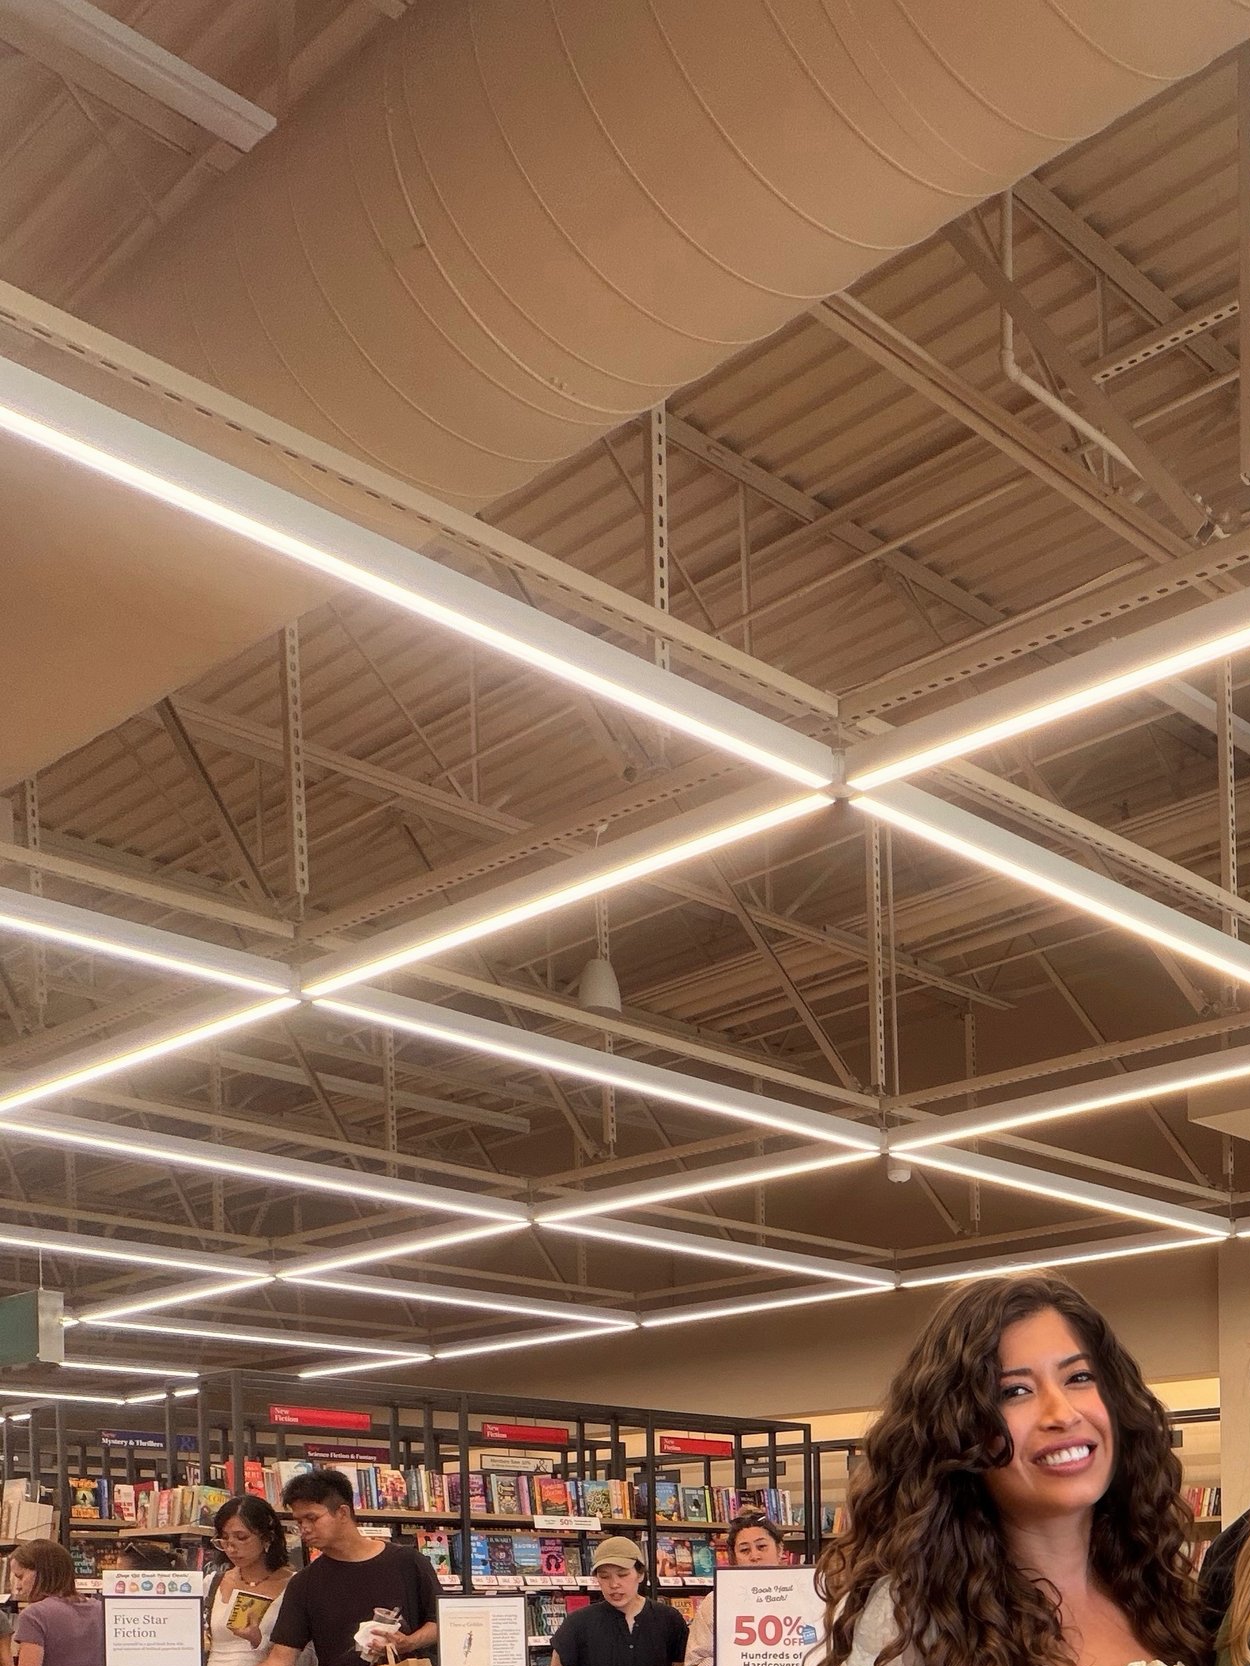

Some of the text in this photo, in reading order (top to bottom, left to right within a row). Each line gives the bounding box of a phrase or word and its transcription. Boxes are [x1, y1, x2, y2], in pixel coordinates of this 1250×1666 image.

[274, 1407, 290, 1416] New
[274, 1414, 299, 1423] Fiction
[487, 1424, 500, 1432] New
[486, 1430, 508, 1439] Fiction
[101, 1437, 128, 1448] Mystery
[135, 1439, 164, 1449] Thrillers
[663, 1444, 682, 1452] Fiction
[330, 1452, 350, 1460] Fiction
[113, 1614, 168, 1625] Five Star
[113, 1627, 157, 1638] Fiction
[733, 1615, 804, 1647] 50%
[740, 1651, 803, 1660] Hundreds of
